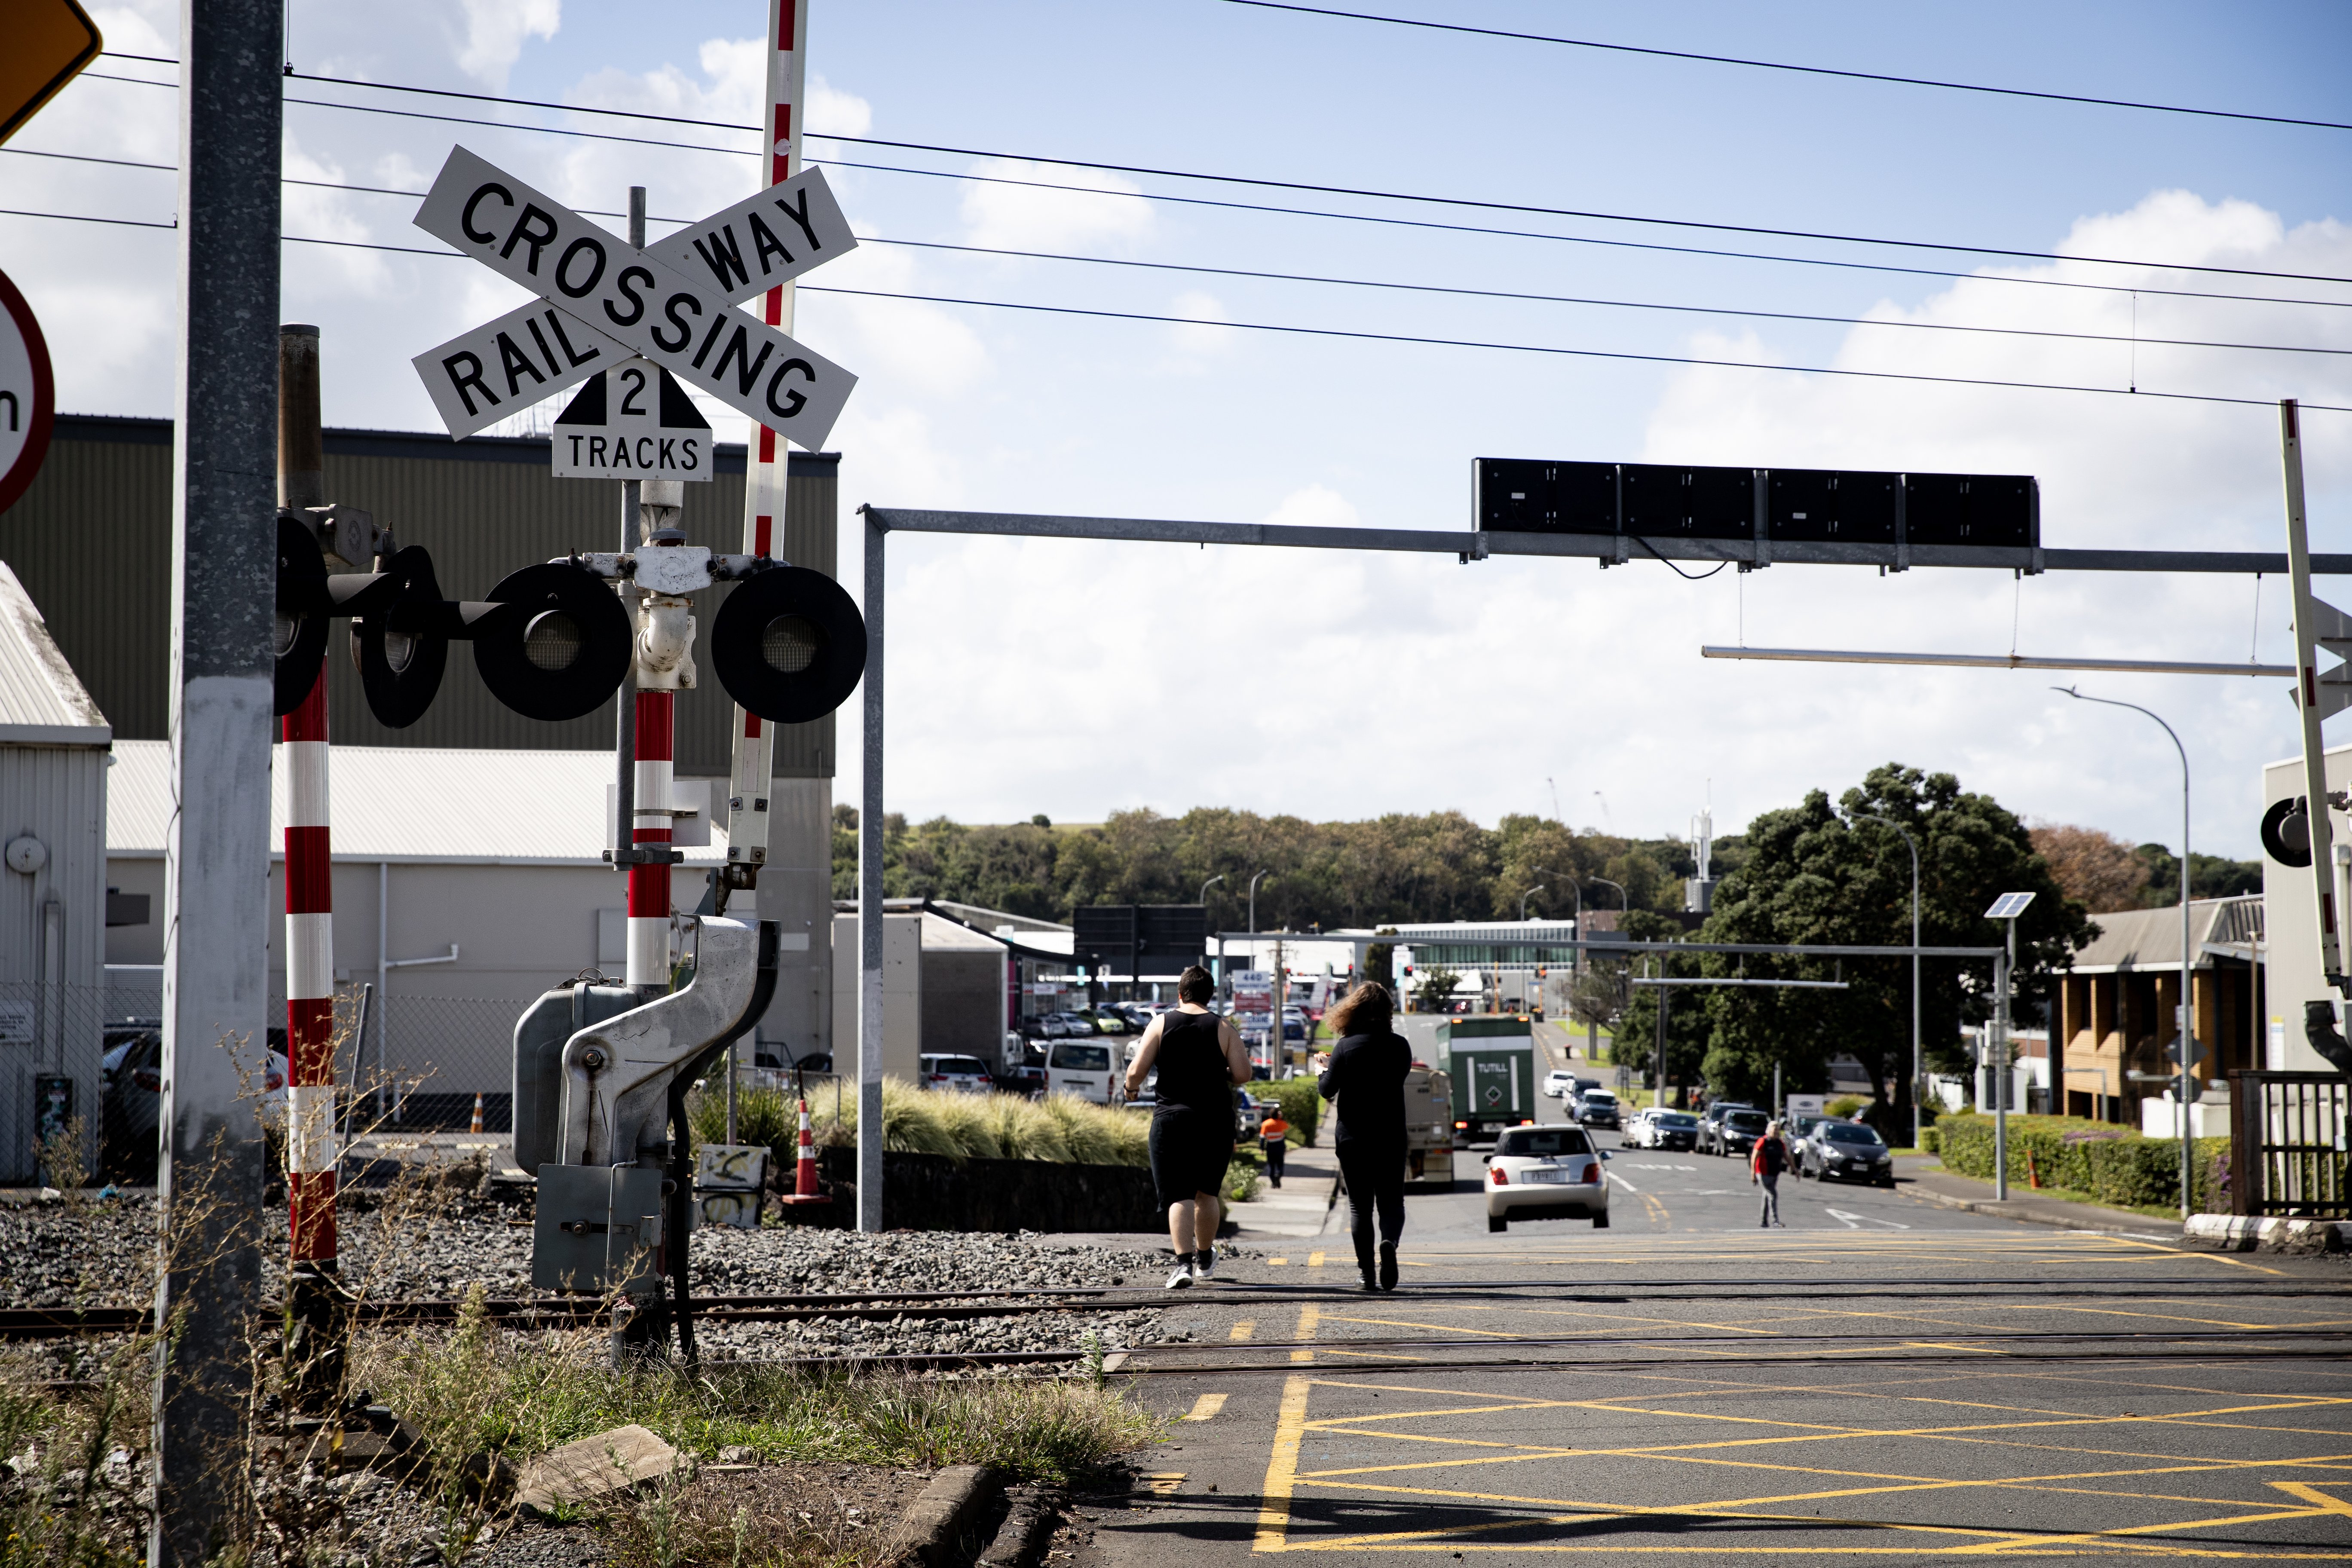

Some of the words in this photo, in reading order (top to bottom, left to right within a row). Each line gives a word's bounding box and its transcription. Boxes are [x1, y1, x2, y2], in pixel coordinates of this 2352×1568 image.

[442, 309, 600, 416] RAIL
[692, 187, 821, 293] WAY
[462, 183, 815, 418] CROSSING
[621, 368, 646, 415] 2
[568, 435, 698, 470] TRACKS
[1243, 973, 1262, 981] 440
[1477, 1063, 1508, 1073] TUTILL
